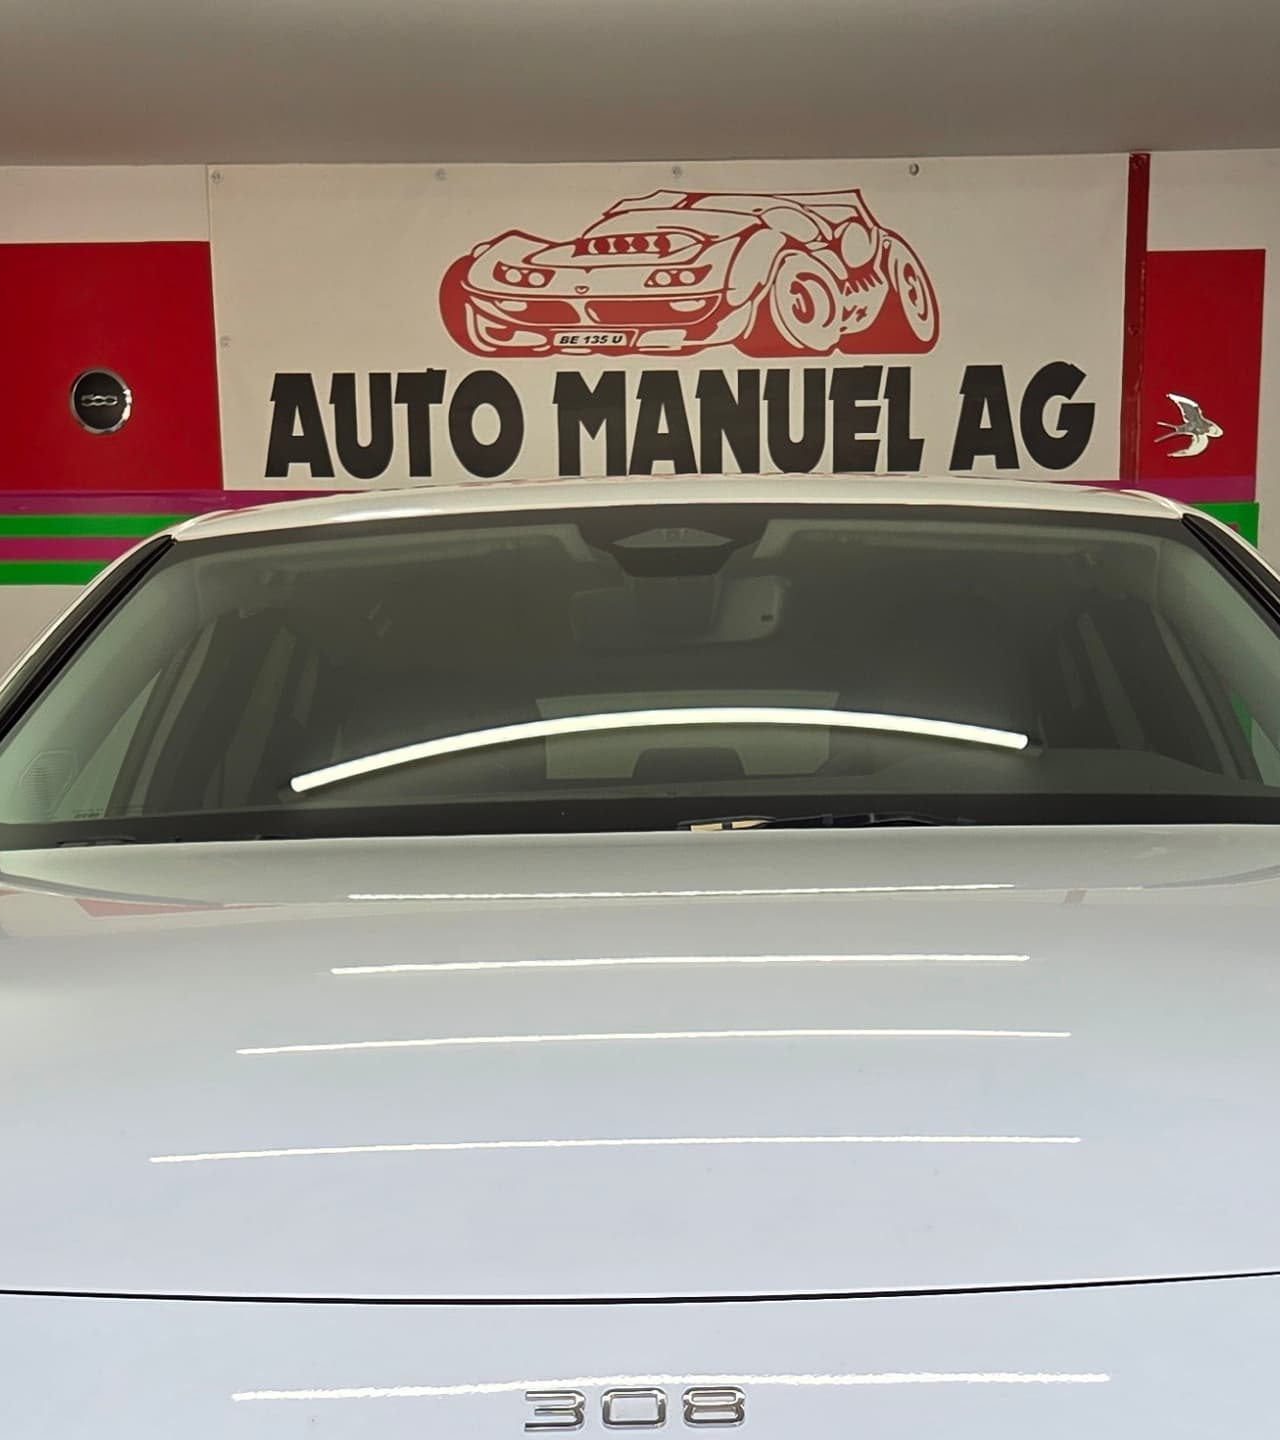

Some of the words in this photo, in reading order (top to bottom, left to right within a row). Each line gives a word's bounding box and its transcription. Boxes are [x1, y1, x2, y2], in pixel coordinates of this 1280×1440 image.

[559, 335, 579, 344] BE
[583, 335, 608, 344] 135
[612, 335, 623, 344] U
[265, 368, 524, 480] AUTO
[553, 365, 925, 477] MANUEL
[948, 360, 1096, 471] AG
[523, 1385, 746, 1432] 308
